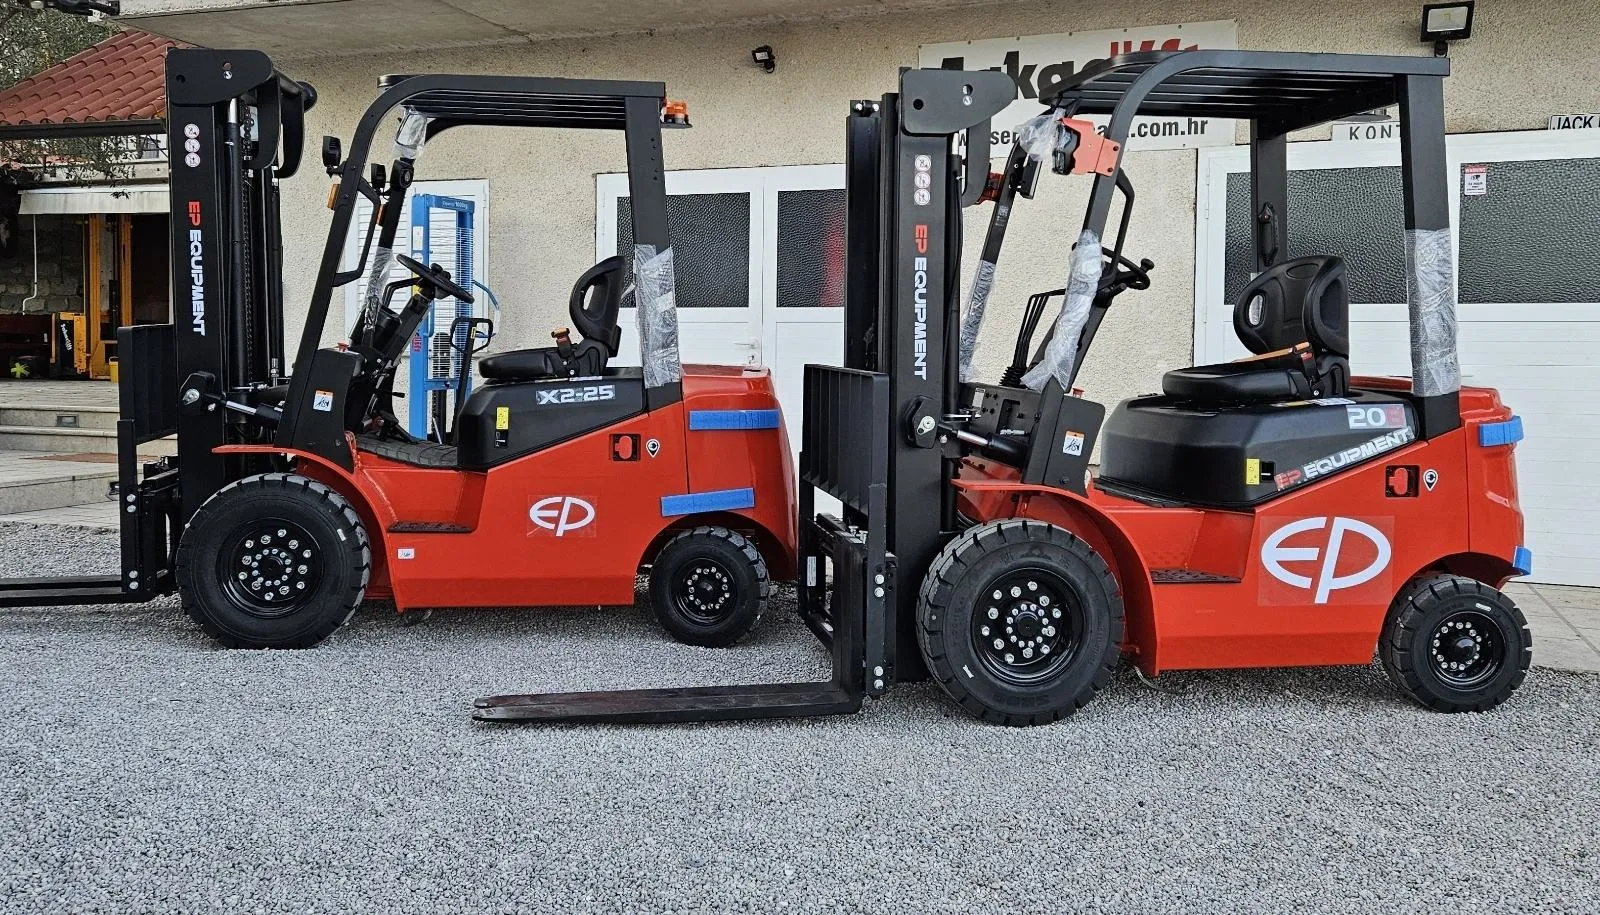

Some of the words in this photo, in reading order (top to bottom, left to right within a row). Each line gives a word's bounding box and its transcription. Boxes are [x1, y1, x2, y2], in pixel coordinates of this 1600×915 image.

[1349, 124, 1400, 140] KON
[188, 201, 201, 226] EP
[915, 224, 928, 253] EP
[189, 229, 206, 336] EQUIPMENT
[914, 257, 928, 381] EQUIPMENT
[538, 385, 615, 405] X2-25
[1274, 469, 1302, 491] EP
[1303, 428, 1410, 479] EQUIPMENT
[529, 496, 596, 537] EP
[1260, 516, 1392, 604] EP
